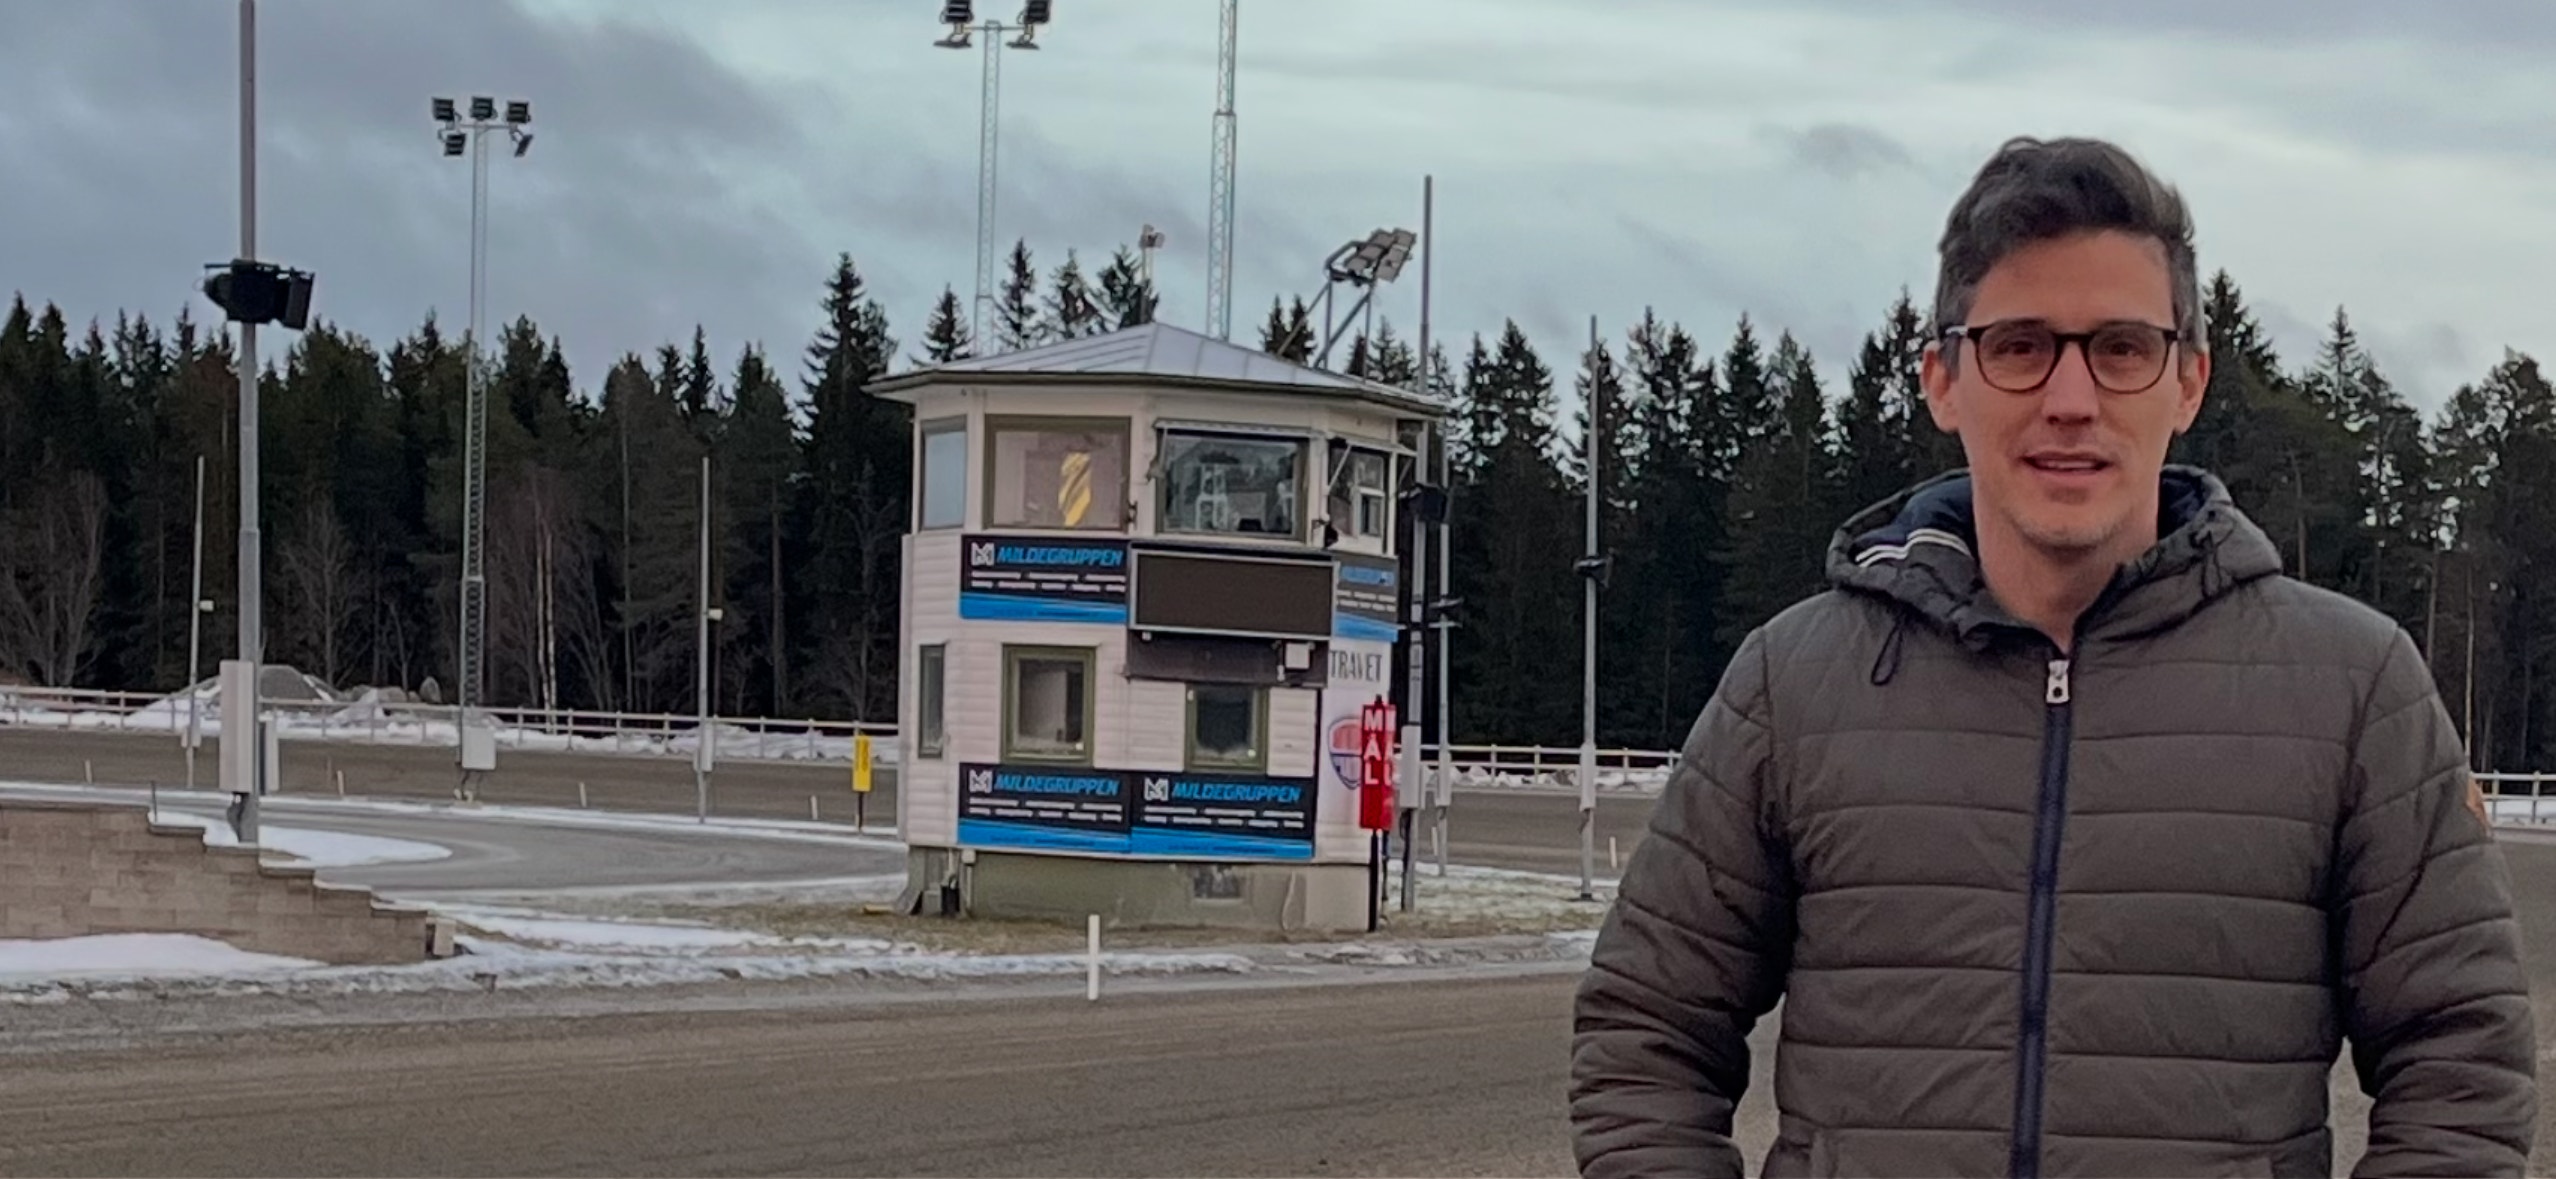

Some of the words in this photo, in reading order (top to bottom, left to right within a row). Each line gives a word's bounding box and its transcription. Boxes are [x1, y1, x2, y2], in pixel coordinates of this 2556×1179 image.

[997, 546, 1123, 566] MILDEGRUPPEN
[1330, 650, 1382, 682] TRAVET
[1363, 708, 1383, 785] MÅL
[994, 774, 1120, 796] MILDEGRUPPEN
[1172, 782, 1301, 803] MILDEGRUPPEN
